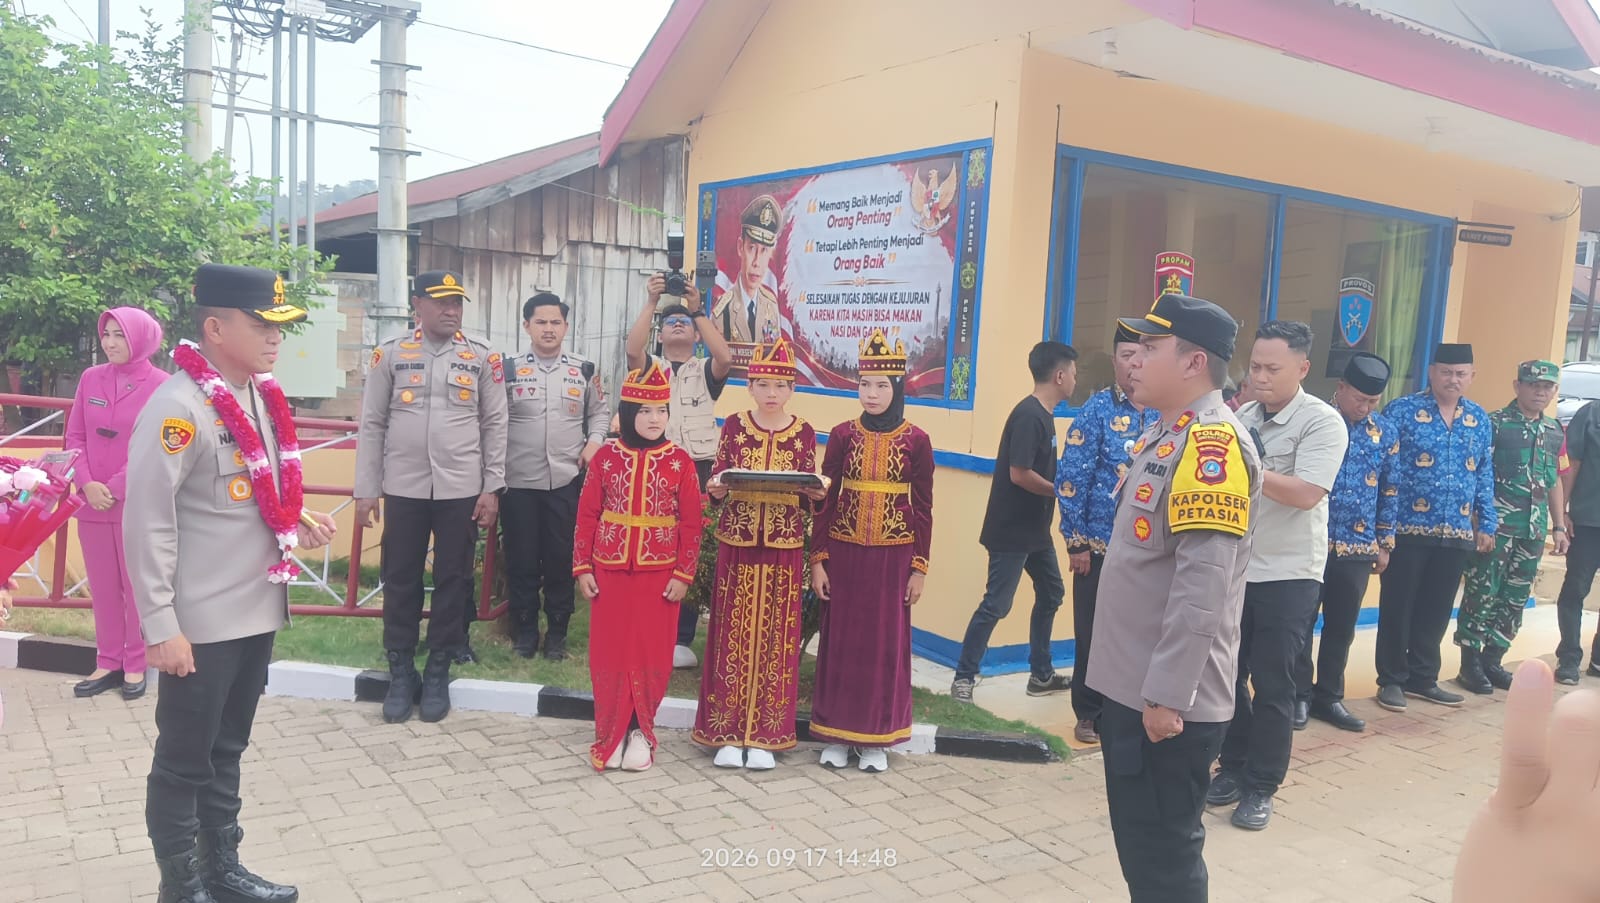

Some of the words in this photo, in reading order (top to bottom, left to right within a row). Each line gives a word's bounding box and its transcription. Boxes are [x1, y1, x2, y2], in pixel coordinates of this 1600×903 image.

[819, 200, 850, 212] Memang
[852, 196, 868, 208] Baik
[870, 191, 903, 207] Menjadi
[827, 214, 854, 230] Orang
[856, 208, 892, 226] Penting
[816, 240, 838, 254] Tetapi
[839, 238, 858, 251] Lebih
[860, 235, 888, 250] Penting
[890, 232, 925, 250] Menjadi
[833, 256, 861, 273] Orang
[863, 253, 885, 269] Baik
[1160, 256, 1191, 267] PROPAM
[806, 293, 840, 305] SELESAIKAN
[842, 293, 860, 304] TUGAS
[862, 292, 888, 304] DENGAN
[889, 292, 930, 304] KEJUJURAN
[809, 309, 835, 321] KARENA
[837, 309, 850, 321] KITA
[852, 309, 873, 321] MASIH
[874, 309, 890, 321] BISA
[892, 309, 922, 322] MAKAN
[831, 325, 846, 337] NASI
[847, 326, 862, 337] DAN
[863, 325, 889, 338] GAM
[450, 362, 481, 375] POLRI
[563, 377, 585, 386] POLRI
[1143, 461, 1168, 478] POLRI
[1171, 493, 1247, 511] KAPOLSEK
[1177, 508, 1240, 524] PETASIA
